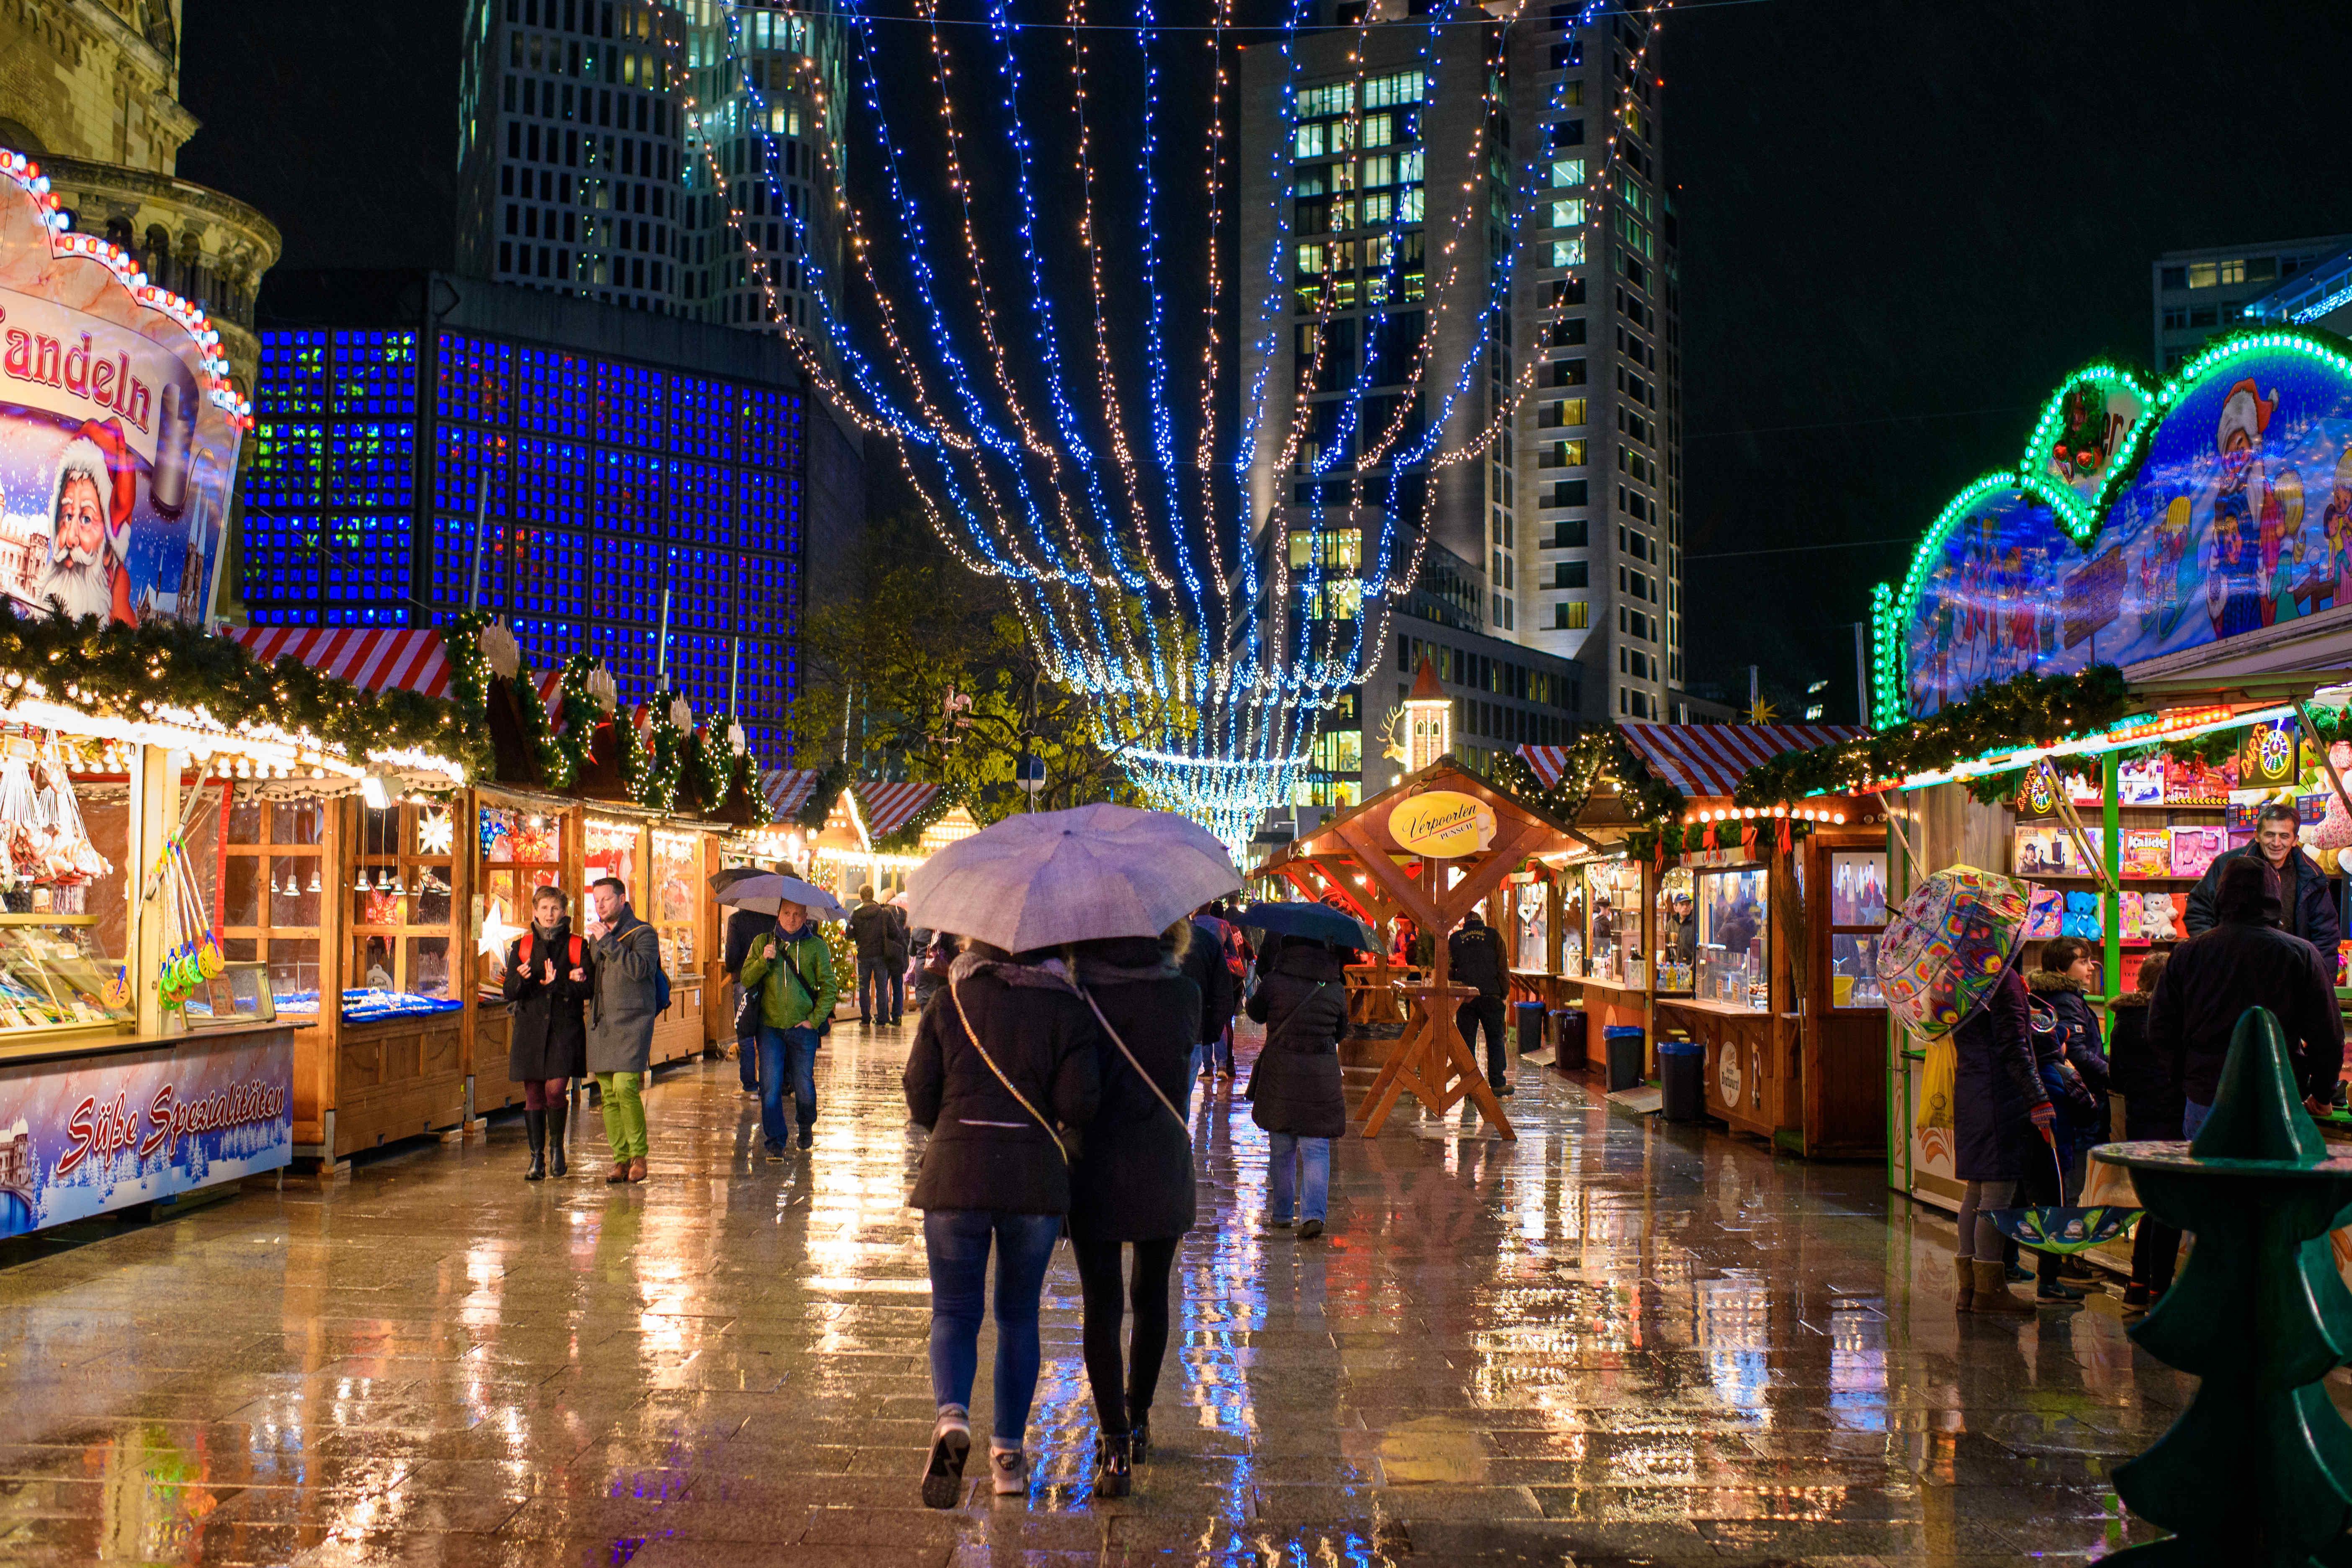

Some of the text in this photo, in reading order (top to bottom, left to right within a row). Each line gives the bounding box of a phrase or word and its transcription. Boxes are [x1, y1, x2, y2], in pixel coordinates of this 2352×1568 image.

[0, 305, 154, 434] andeln
[1402, 803, 1476, 838] Verpoorten
[1440, 823, 1473, 840] PUNSCH
[57, 1079, 285, 1174] Süße Spezialitäten
